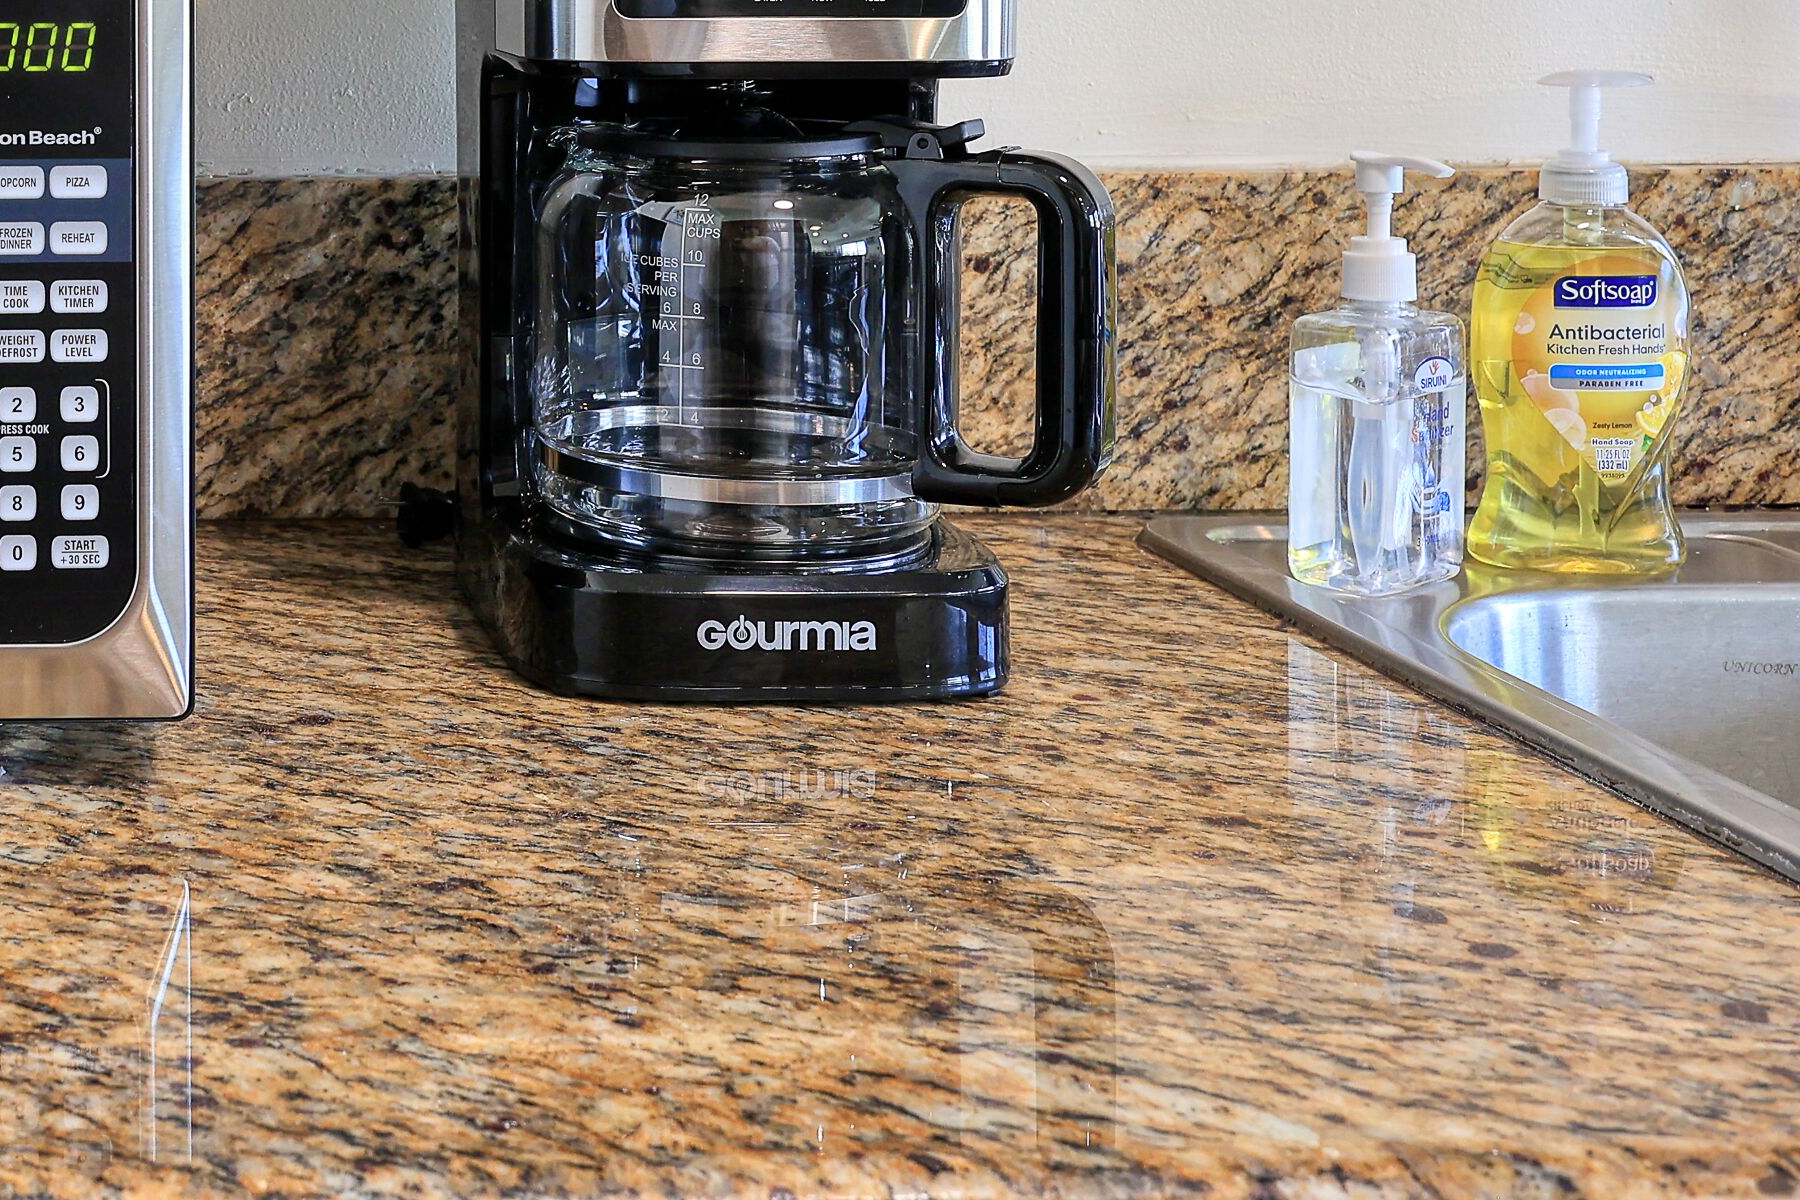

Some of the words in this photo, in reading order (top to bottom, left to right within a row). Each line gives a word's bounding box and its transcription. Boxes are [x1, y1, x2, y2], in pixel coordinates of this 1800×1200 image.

[65, 177, 90, 187] PIZZA
[694, 193, 709, 207] 12
[687, 212, 715, 225] MAX
[0, 228, 33, 239] FROZEN
[61, 232, 95, 243] REHEAT
[687, 226, 721, 239] CUPS
[0, 239, 32, 250] DINNER
[688, 250, 703, 262] 10
[640, 256, 679, 268] CUBES
[654, 271, 678, 282] PER
[4, 286, 28, 296] TIME
[58, 285, 99, 296] KITCHEN
[627, 282, 677, 298] SERVING
[3, 298, 29, 309] COOK
[64, 297, 94, 308] TIMER
[663, 302, 671, 313] 6
[693, 303, 701, 314] 8
[652, 319, 677, 331] MAX
[1549, 323, 1665, 340] Antibacterial
[61, 335, 96, 345] POWER
[65, 346, 93, 357] LEVEL
[1547, 343, 1595, 354] Kitchen
[1598, 345, 1630, 355] Fresh
[662, 351, 671, 362] 4
[692, 354, 701, 365] 6
[12, 398, 22, 413] 2
[74, 397, 85, 412] 3
[691, 412, 699, 424] 4
[25, 424, 50, 434] COOK
[12, 447, 22, 462] 5
[74, 446, 85, 461] 6
[1614, 450, 1621, 460] FL
[1598, 460, 1615, 471] (332
[12, 496, 22, 511] 8
[74, 495, 85, 510] 9
[64, 540, 96, 550] START
[12, 546, 22, 560] 0
[82, 554, 100, 564] SEC
[1723, 660, 1798, 675] UNICORN
